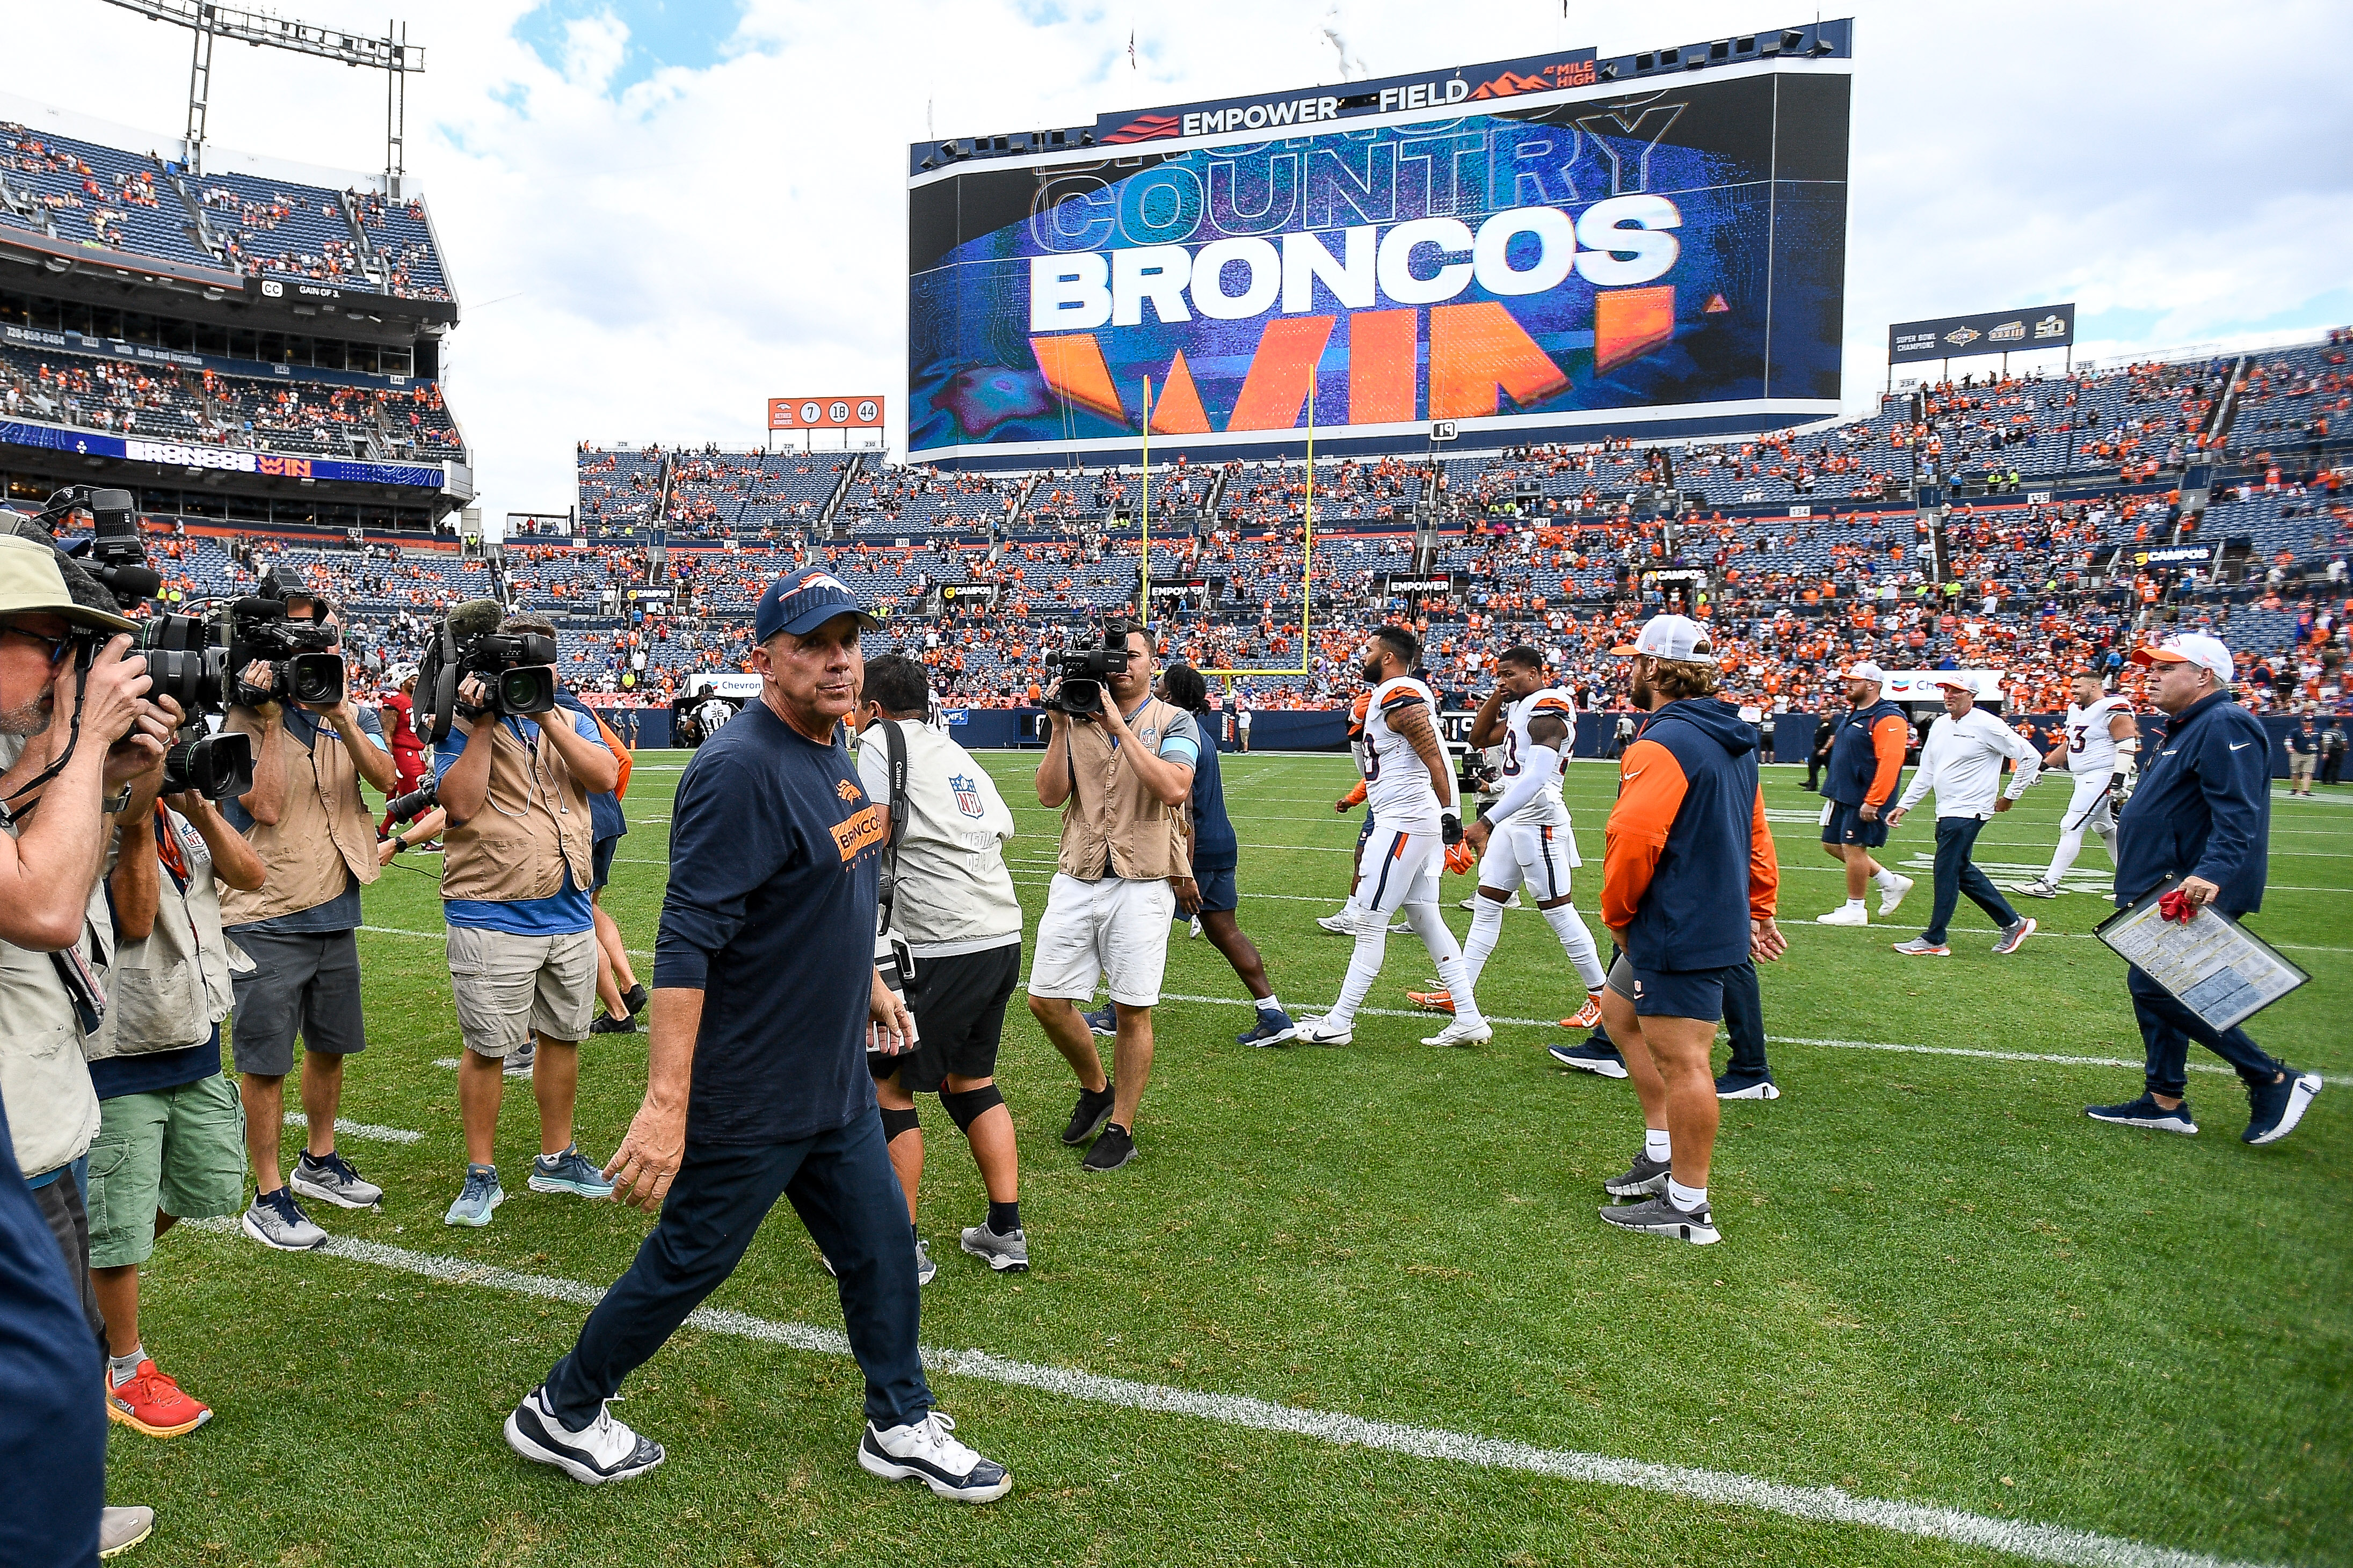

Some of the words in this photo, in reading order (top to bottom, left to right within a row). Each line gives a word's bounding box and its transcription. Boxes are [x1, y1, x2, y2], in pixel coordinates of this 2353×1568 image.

[1557, 60, 1594, 75] MILE
[1556, 71, 1596, 89] HIGH
[1183, 96, 1340, 136] EMPOWER
[1379, 79, 1470, 112] FIELD
[1030, 101, 1689, 253] COUNTRY
[1030, 194, 1682, 333] BRONCOS
[265, 284, 279, 294] CC
[299, 286, 319, 296] GAIN
[320, 288, 332, 297] OF
[2035, 319, 2066, 336] 50
[1896, 335, 1916, 344] SUPER
[1918, 333, 1936, 341] BOWL
[1897, 340, 1935, 352] CHAMPIONS
[1029, 286, 1675, 433] WIN
[807, 406, 814, 419] 7
[833, 406, 846, 418] 18
[860, 405, 874, 418] 44
[1439, 424, 1454, 436] 19
[257, 455, 311, 477] WIN
[2148, 549, 2210, 562] CAMPOS
[955, 586, 992, 595] CAMPOS
[1391, 581, 1449, 592] EMPOWER
[637, 589, 671, 598] CAMPOS
[722, 681, 760, 689] Chevron
[711, 710, 724, 718] 36
[1141, 735, 1154, 743] NFL
[958, 793, 982, 814] NFL
